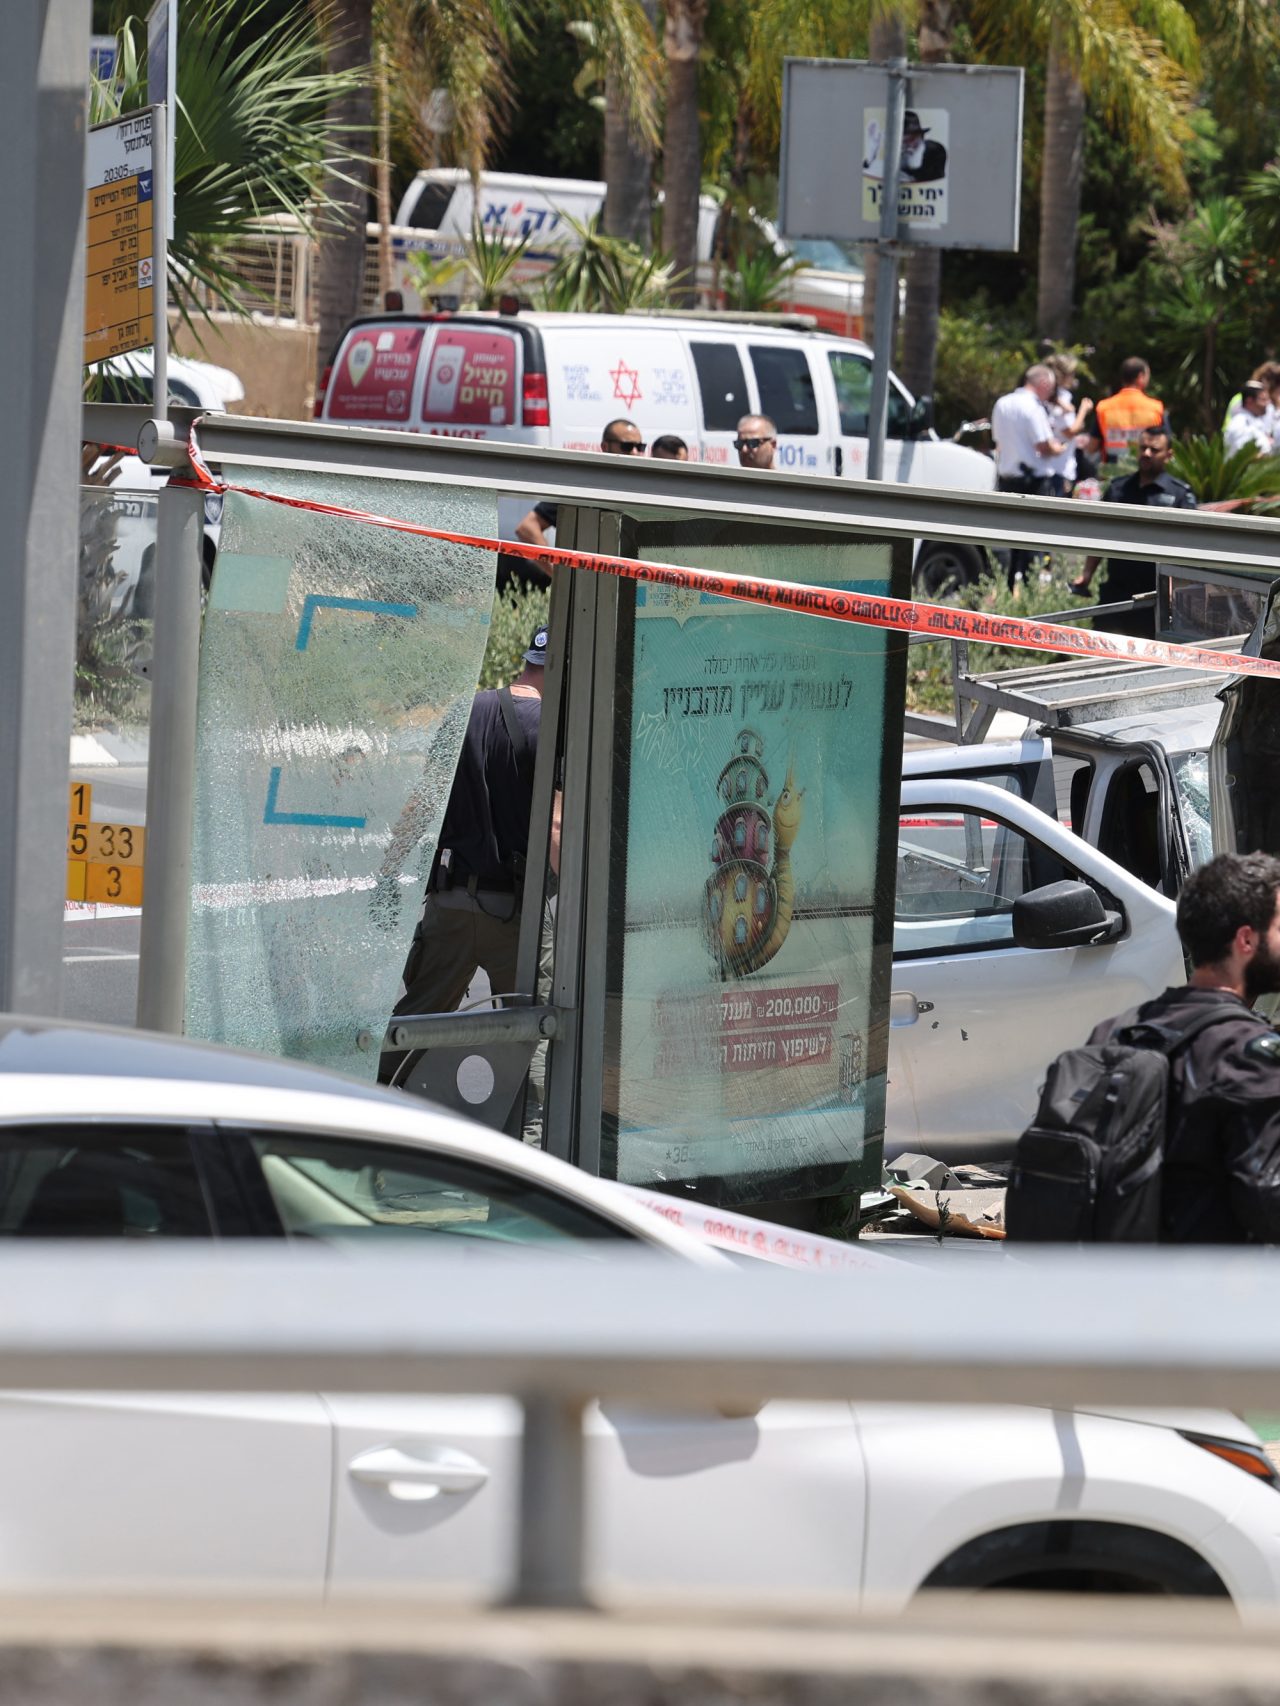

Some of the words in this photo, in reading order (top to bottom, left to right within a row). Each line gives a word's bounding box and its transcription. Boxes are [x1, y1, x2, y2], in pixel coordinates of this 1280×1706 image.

[103, 163, 129, 183] 20305
[919, 187, 943, 201] יחי
[463, 361, 508, 386] מציל
[459, 386, 504, 406] חיים
[778, 445, 804, 466] 101
[663, 685, 733, 721] מהבניין
[99, 825, 133, 859] 33
[106, 866, 122, 897] 3
[732, 1040, 776, 1064] חזיתות
[781, 1031, 828, 1063] לשיפוץ
